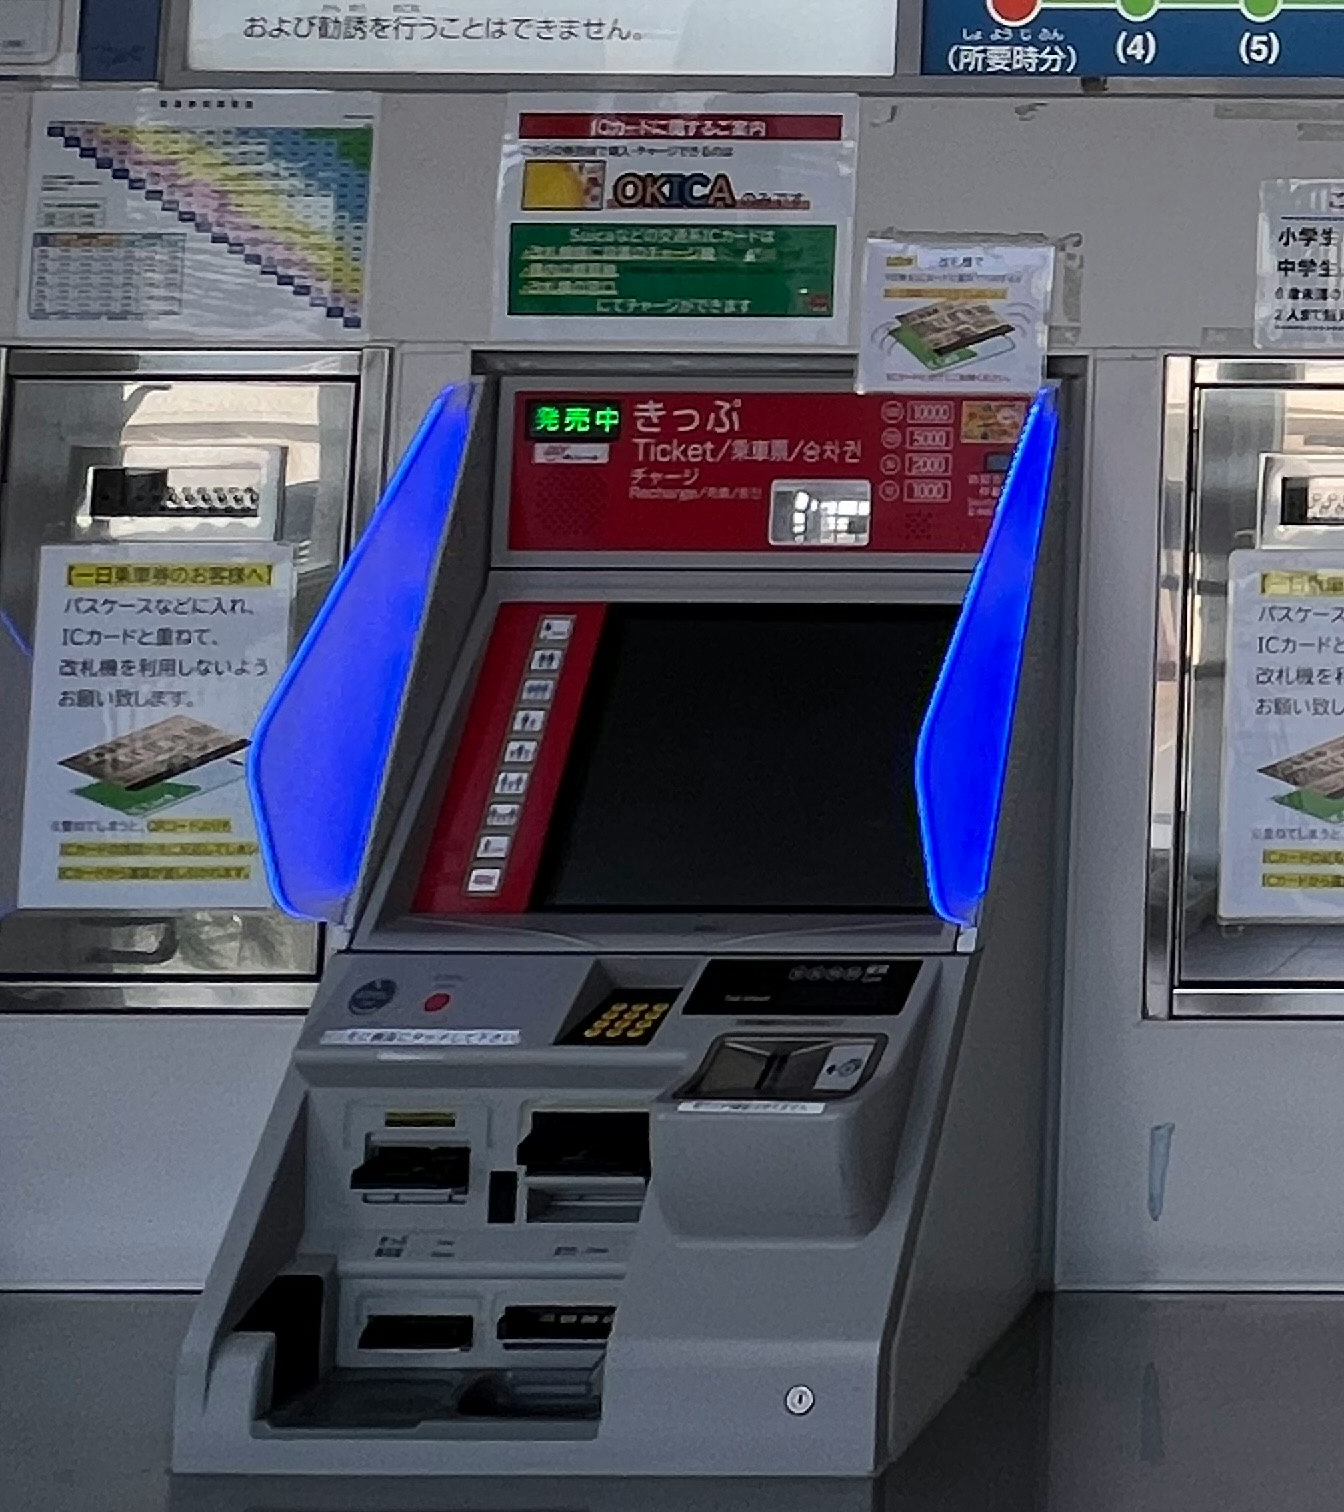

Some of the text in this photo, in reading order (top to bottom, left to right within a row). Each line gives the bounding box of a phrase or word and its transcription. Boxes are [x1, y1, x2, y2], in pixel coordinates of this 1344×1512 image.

[947, 46, 1077, 74] (所要時分)
[1115, 35, 1156, 66] (4)
[1238, 35, 1280, 66] (5)
[613, 173, 736, 208] OKICA
[535, 406, 620, 433] 発売中
[633, 399, 742, 433] きっぷ
